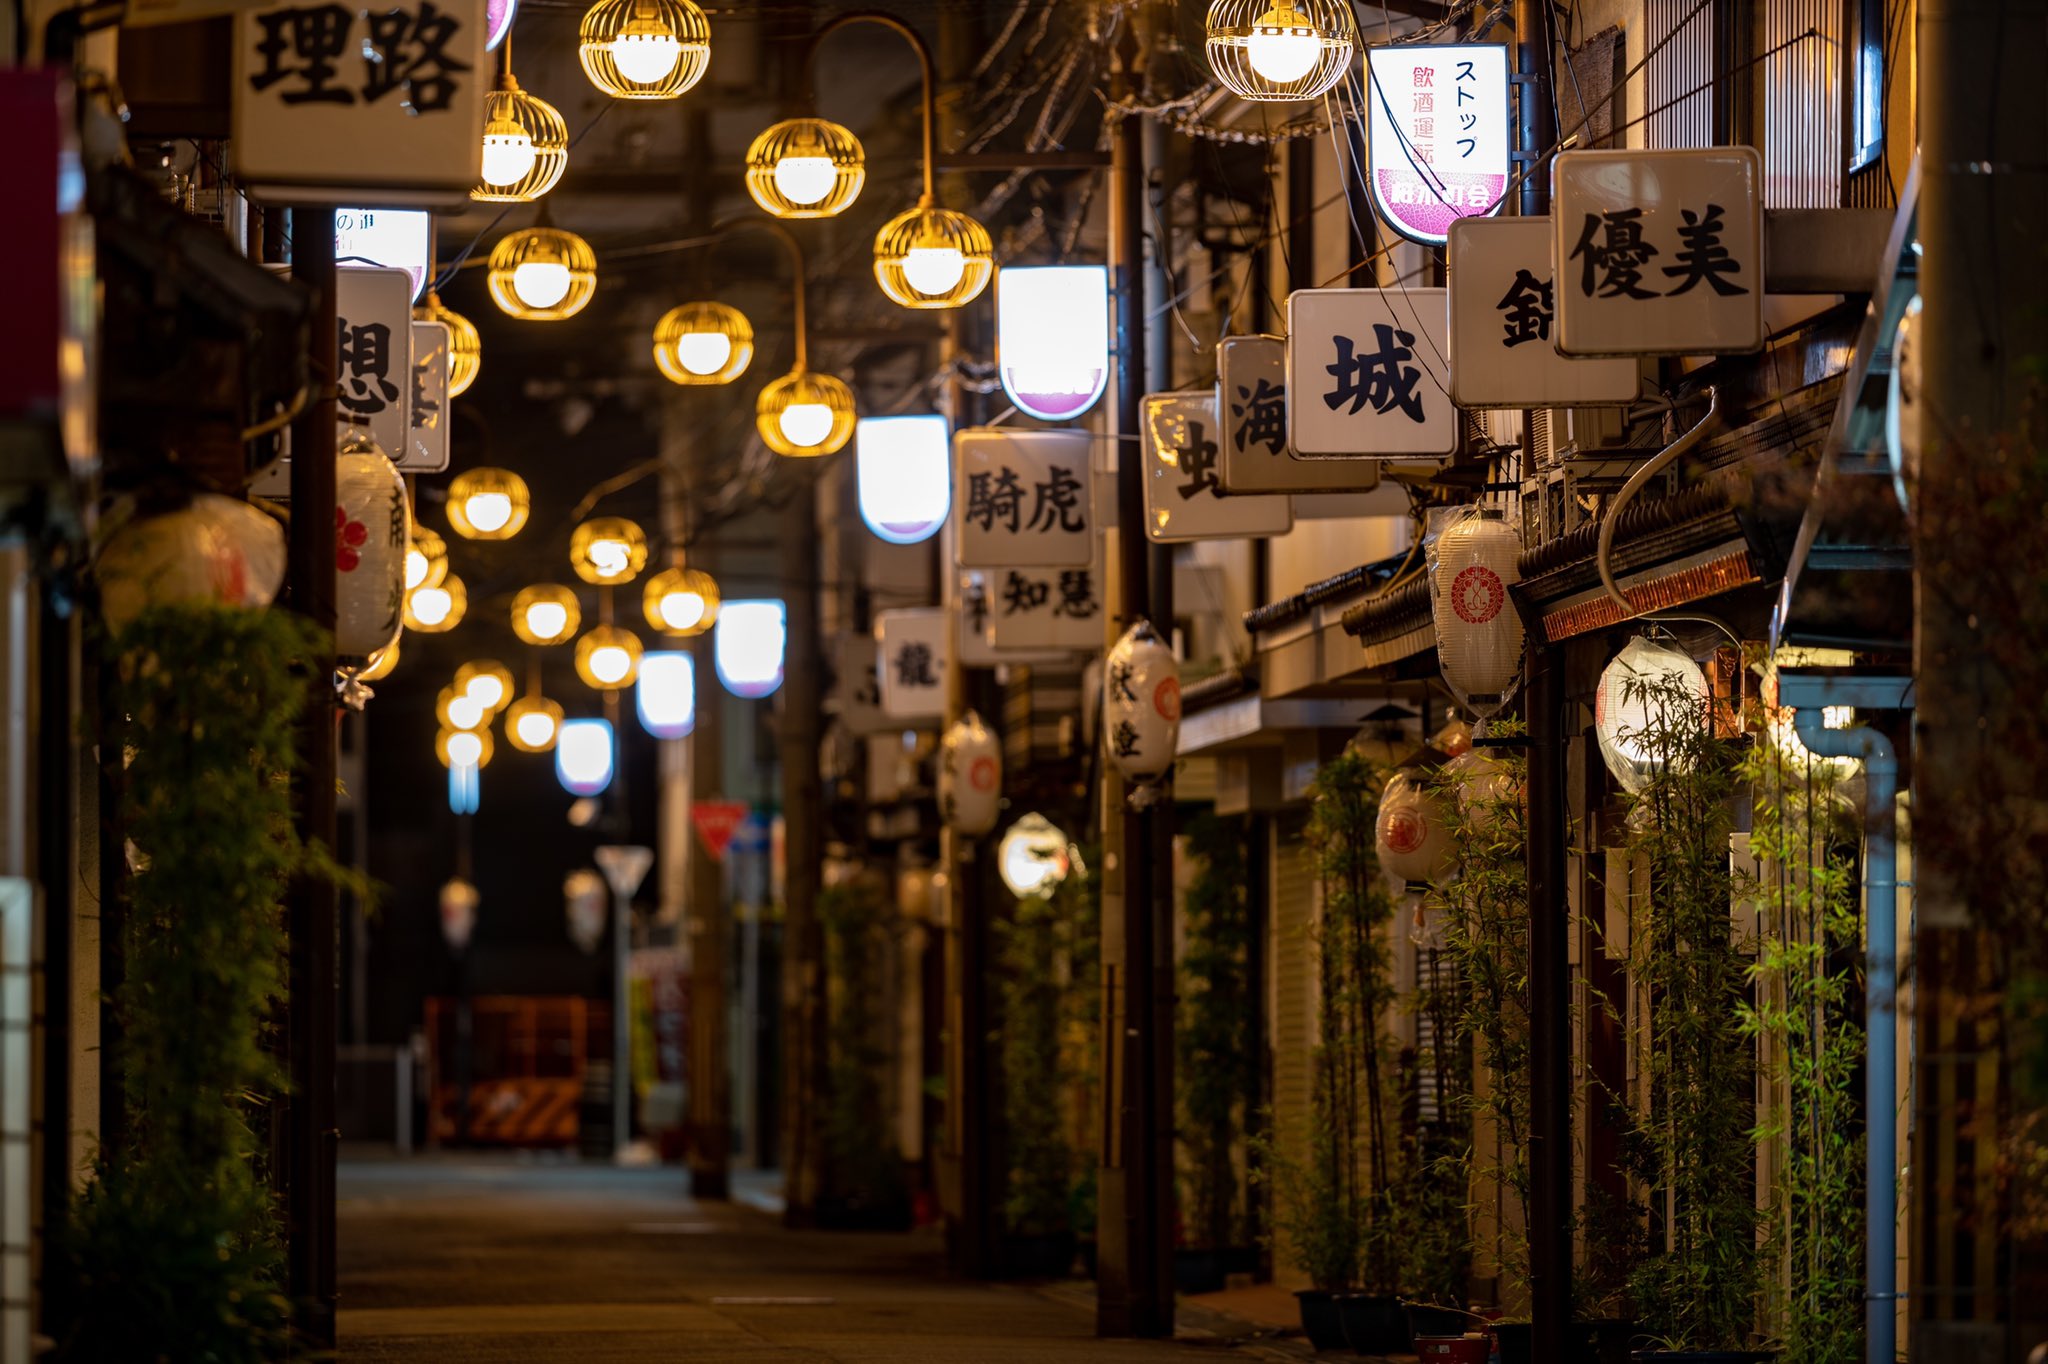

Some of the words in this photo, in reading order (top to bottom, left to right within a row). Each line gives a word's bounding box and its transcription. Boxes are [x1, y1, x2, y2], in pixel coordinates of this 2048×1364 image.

[250, 1, 474, 114] 理路
[1412, 66, 1435, 164] 飲酒運転
[1455, 61, 1478, 158] ストップ
[1568, 203, 1750, 300] 優美
[1323, 323, 1426, 423] 城
[965, 464, 1086, 534] 騎虎
